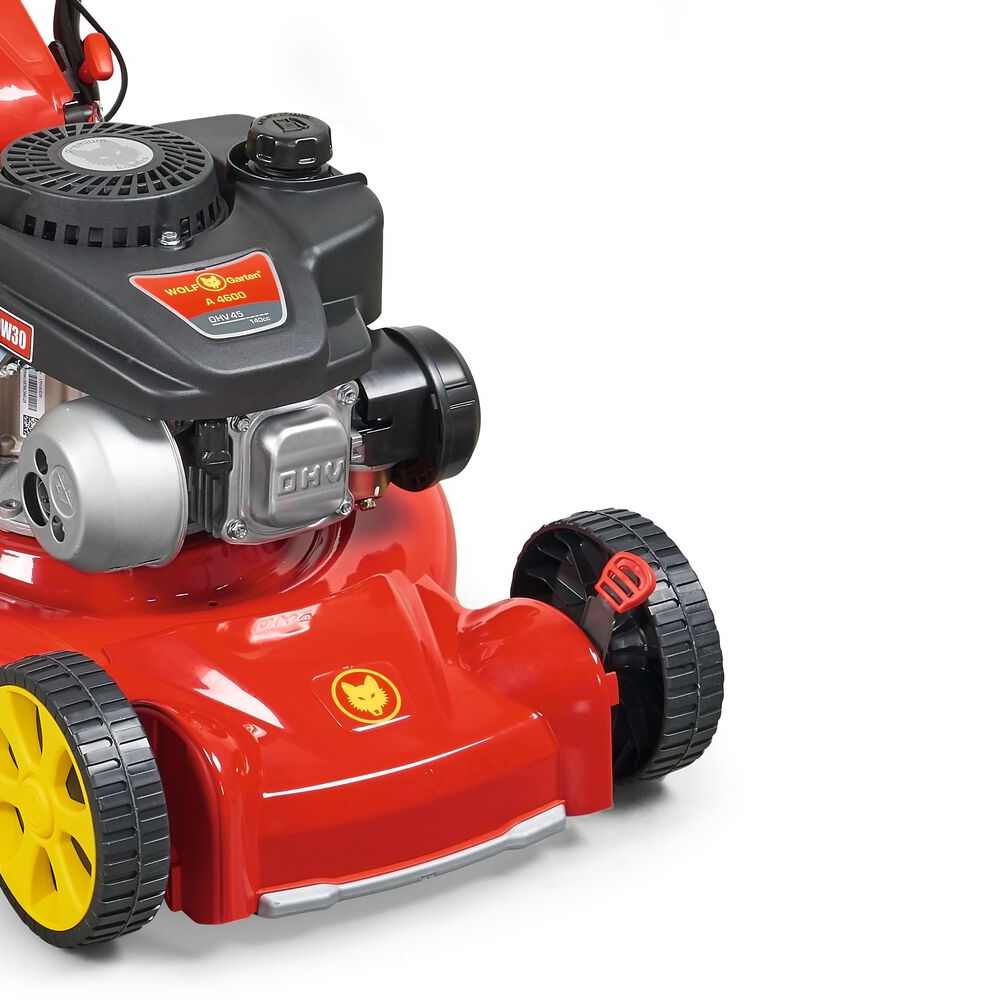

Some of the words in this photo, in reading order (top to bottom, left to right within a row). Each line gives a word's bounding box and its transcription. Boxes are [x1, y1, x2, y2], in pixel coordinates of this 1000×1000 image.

[164, 283, 199, 297] WOLF
[225, 272, 262, 284] Garten
[205, 297, 215, 306] A
[217, 291, 247, 304] 4600
[278, 460, 345, 496] OHV
